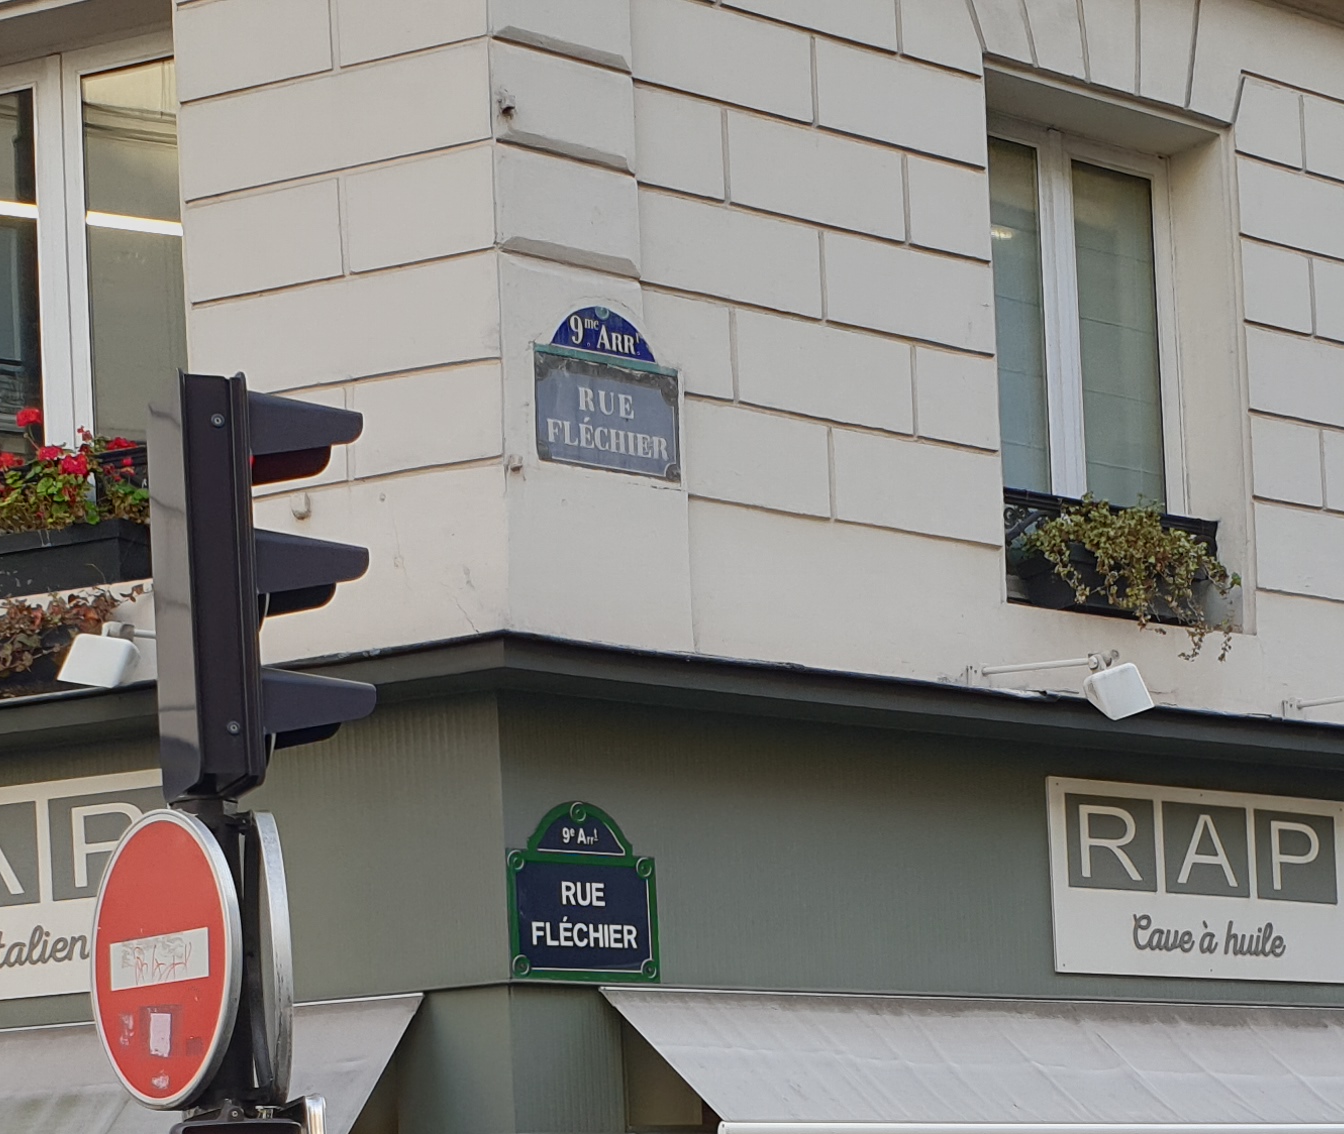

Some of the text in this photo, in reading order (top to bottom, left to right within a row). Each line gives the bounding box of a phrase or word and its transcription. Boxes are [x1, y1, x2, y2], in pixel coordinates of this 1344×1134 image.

[579, 386, 635, 419] RUE
[546, 417, 669, 461] FLÉCHIER
[1078, 804, 1320, 891] RAP
[560, 880, 606, 907] RUE
[531, 916, 638, 949] FLÉCHIER
[1132, 913, 1286, 957] Cave à huile
